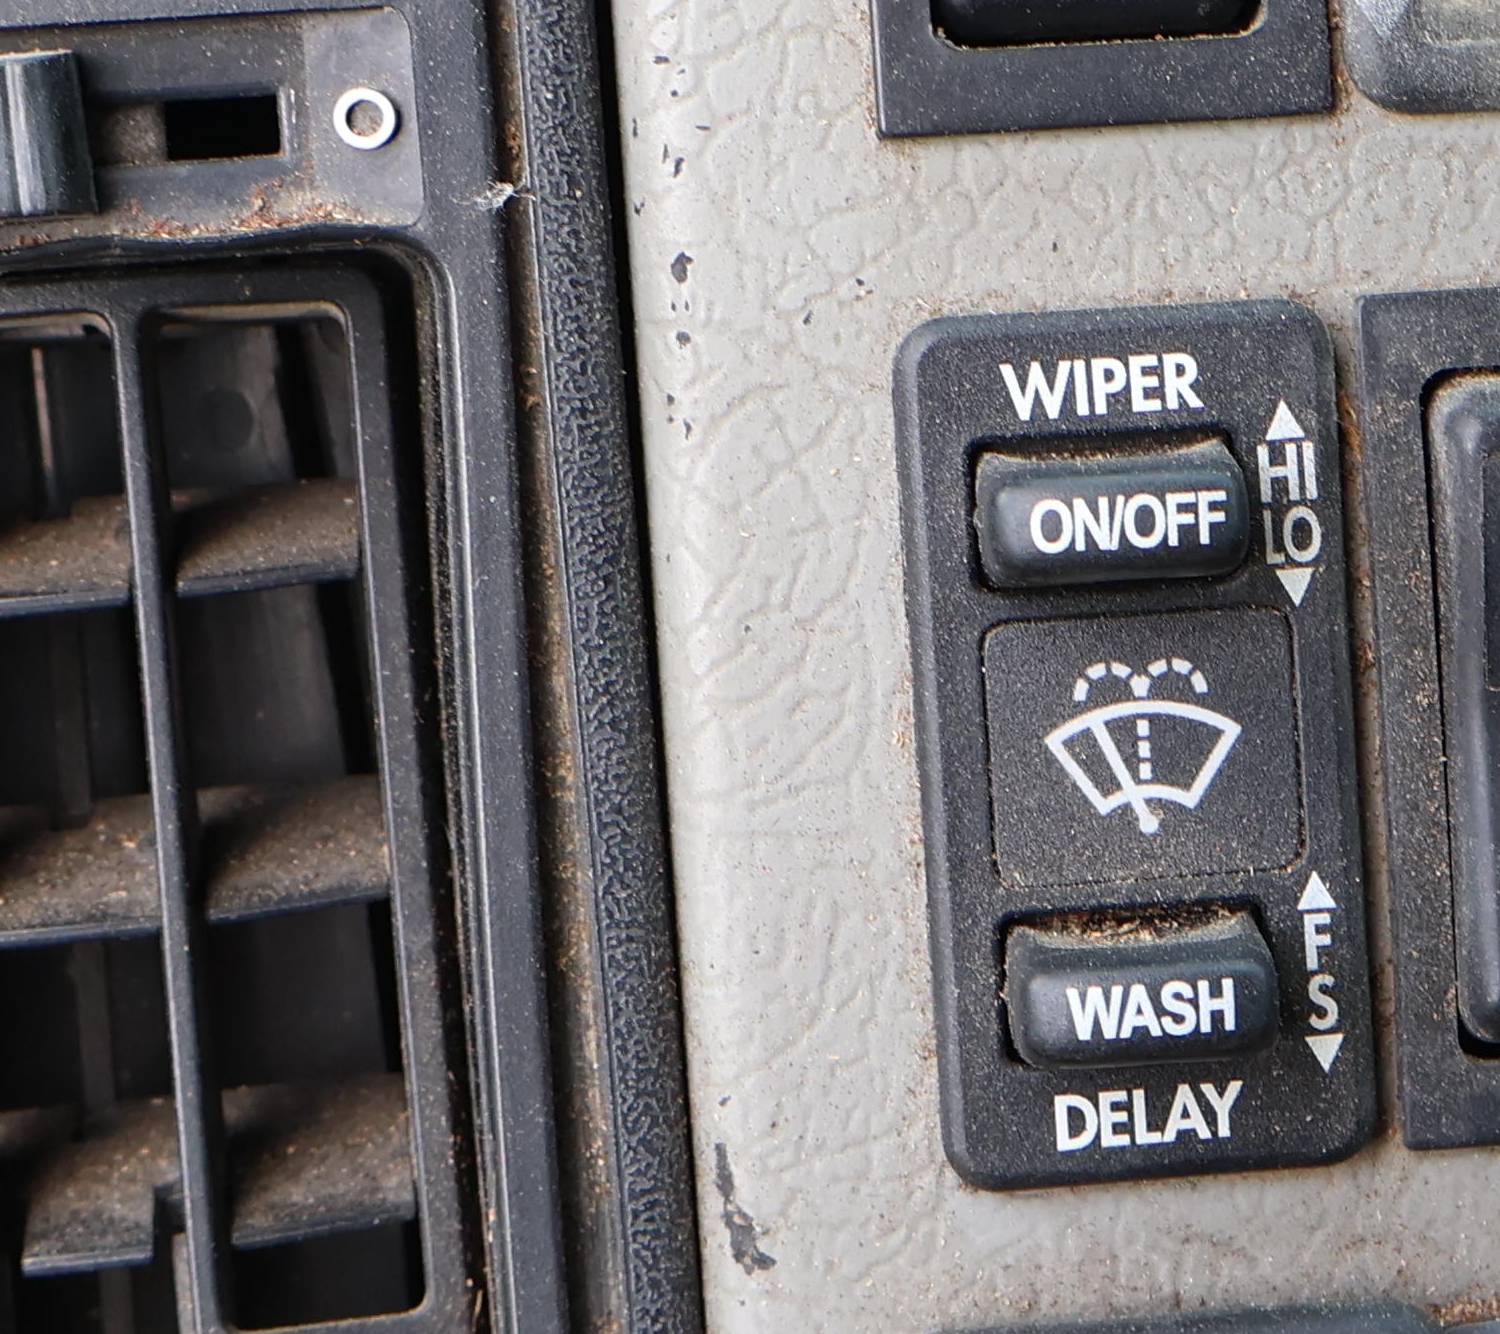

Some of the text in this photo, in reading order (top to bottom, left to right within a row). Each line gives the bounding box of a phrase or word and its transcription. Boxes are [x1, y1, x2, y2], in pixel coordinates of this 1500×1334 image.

[999, 352, 1205, 422] WIPER
[1258, 441, 1318, 505] HI
[1029, 490, 1229, 556] ON/OFF
[1263, 506, 1323, 568] LO
[1302, 913, 1333, 971] F
[1067, 977, 1238, 1042] WASH
[1307, 973, 1339, 1032] S
[1053, 1080, 1244, 1152] DELAY
